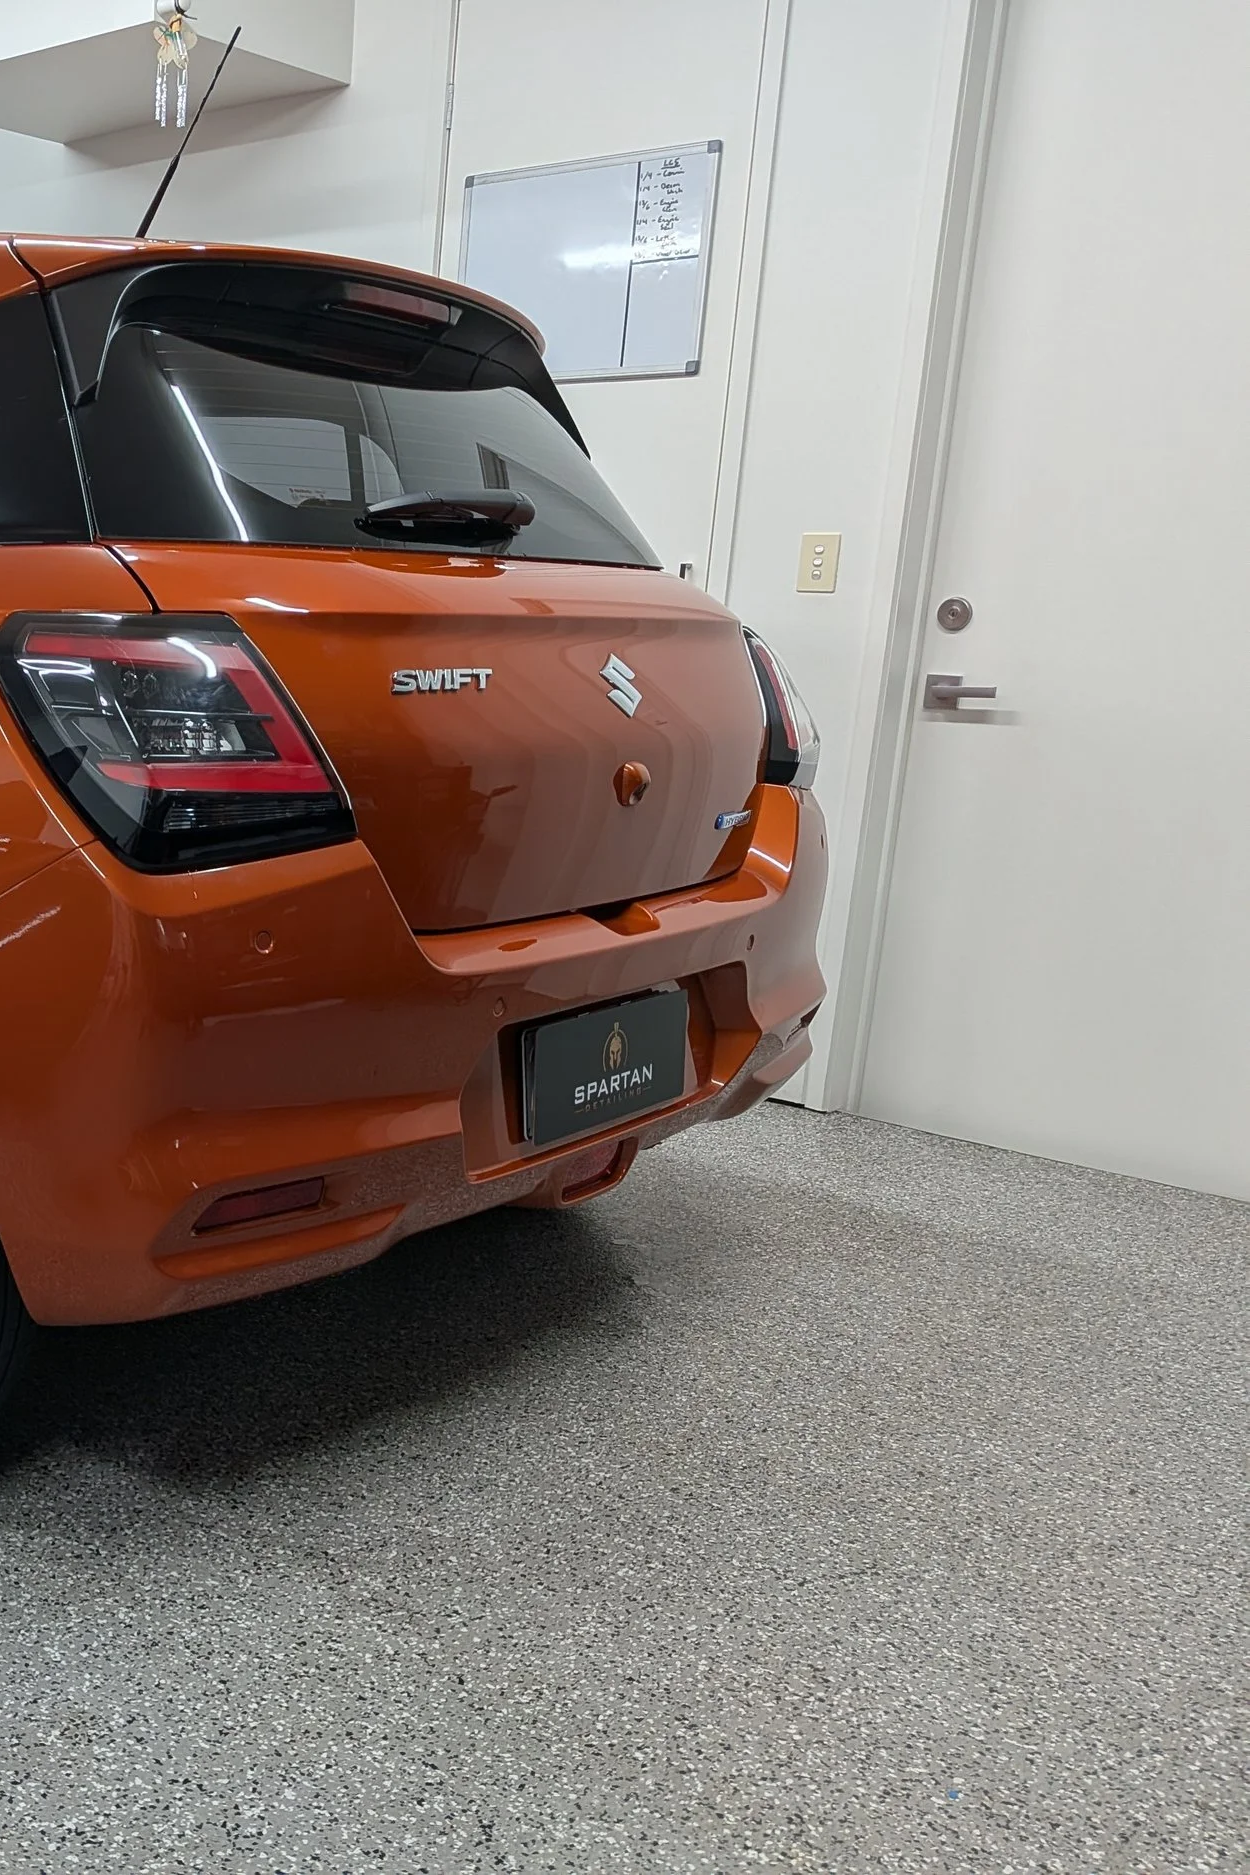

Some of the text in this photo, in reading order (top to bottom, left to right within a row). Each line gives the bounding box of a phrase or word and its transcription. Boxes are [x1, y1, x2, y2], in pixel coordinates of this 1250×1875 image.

[391, 667, 493, 694] SWIFT
[574, 1063, 653, 1105] SPARTAN
[585, 1086, 642, 1112] DETAILING
